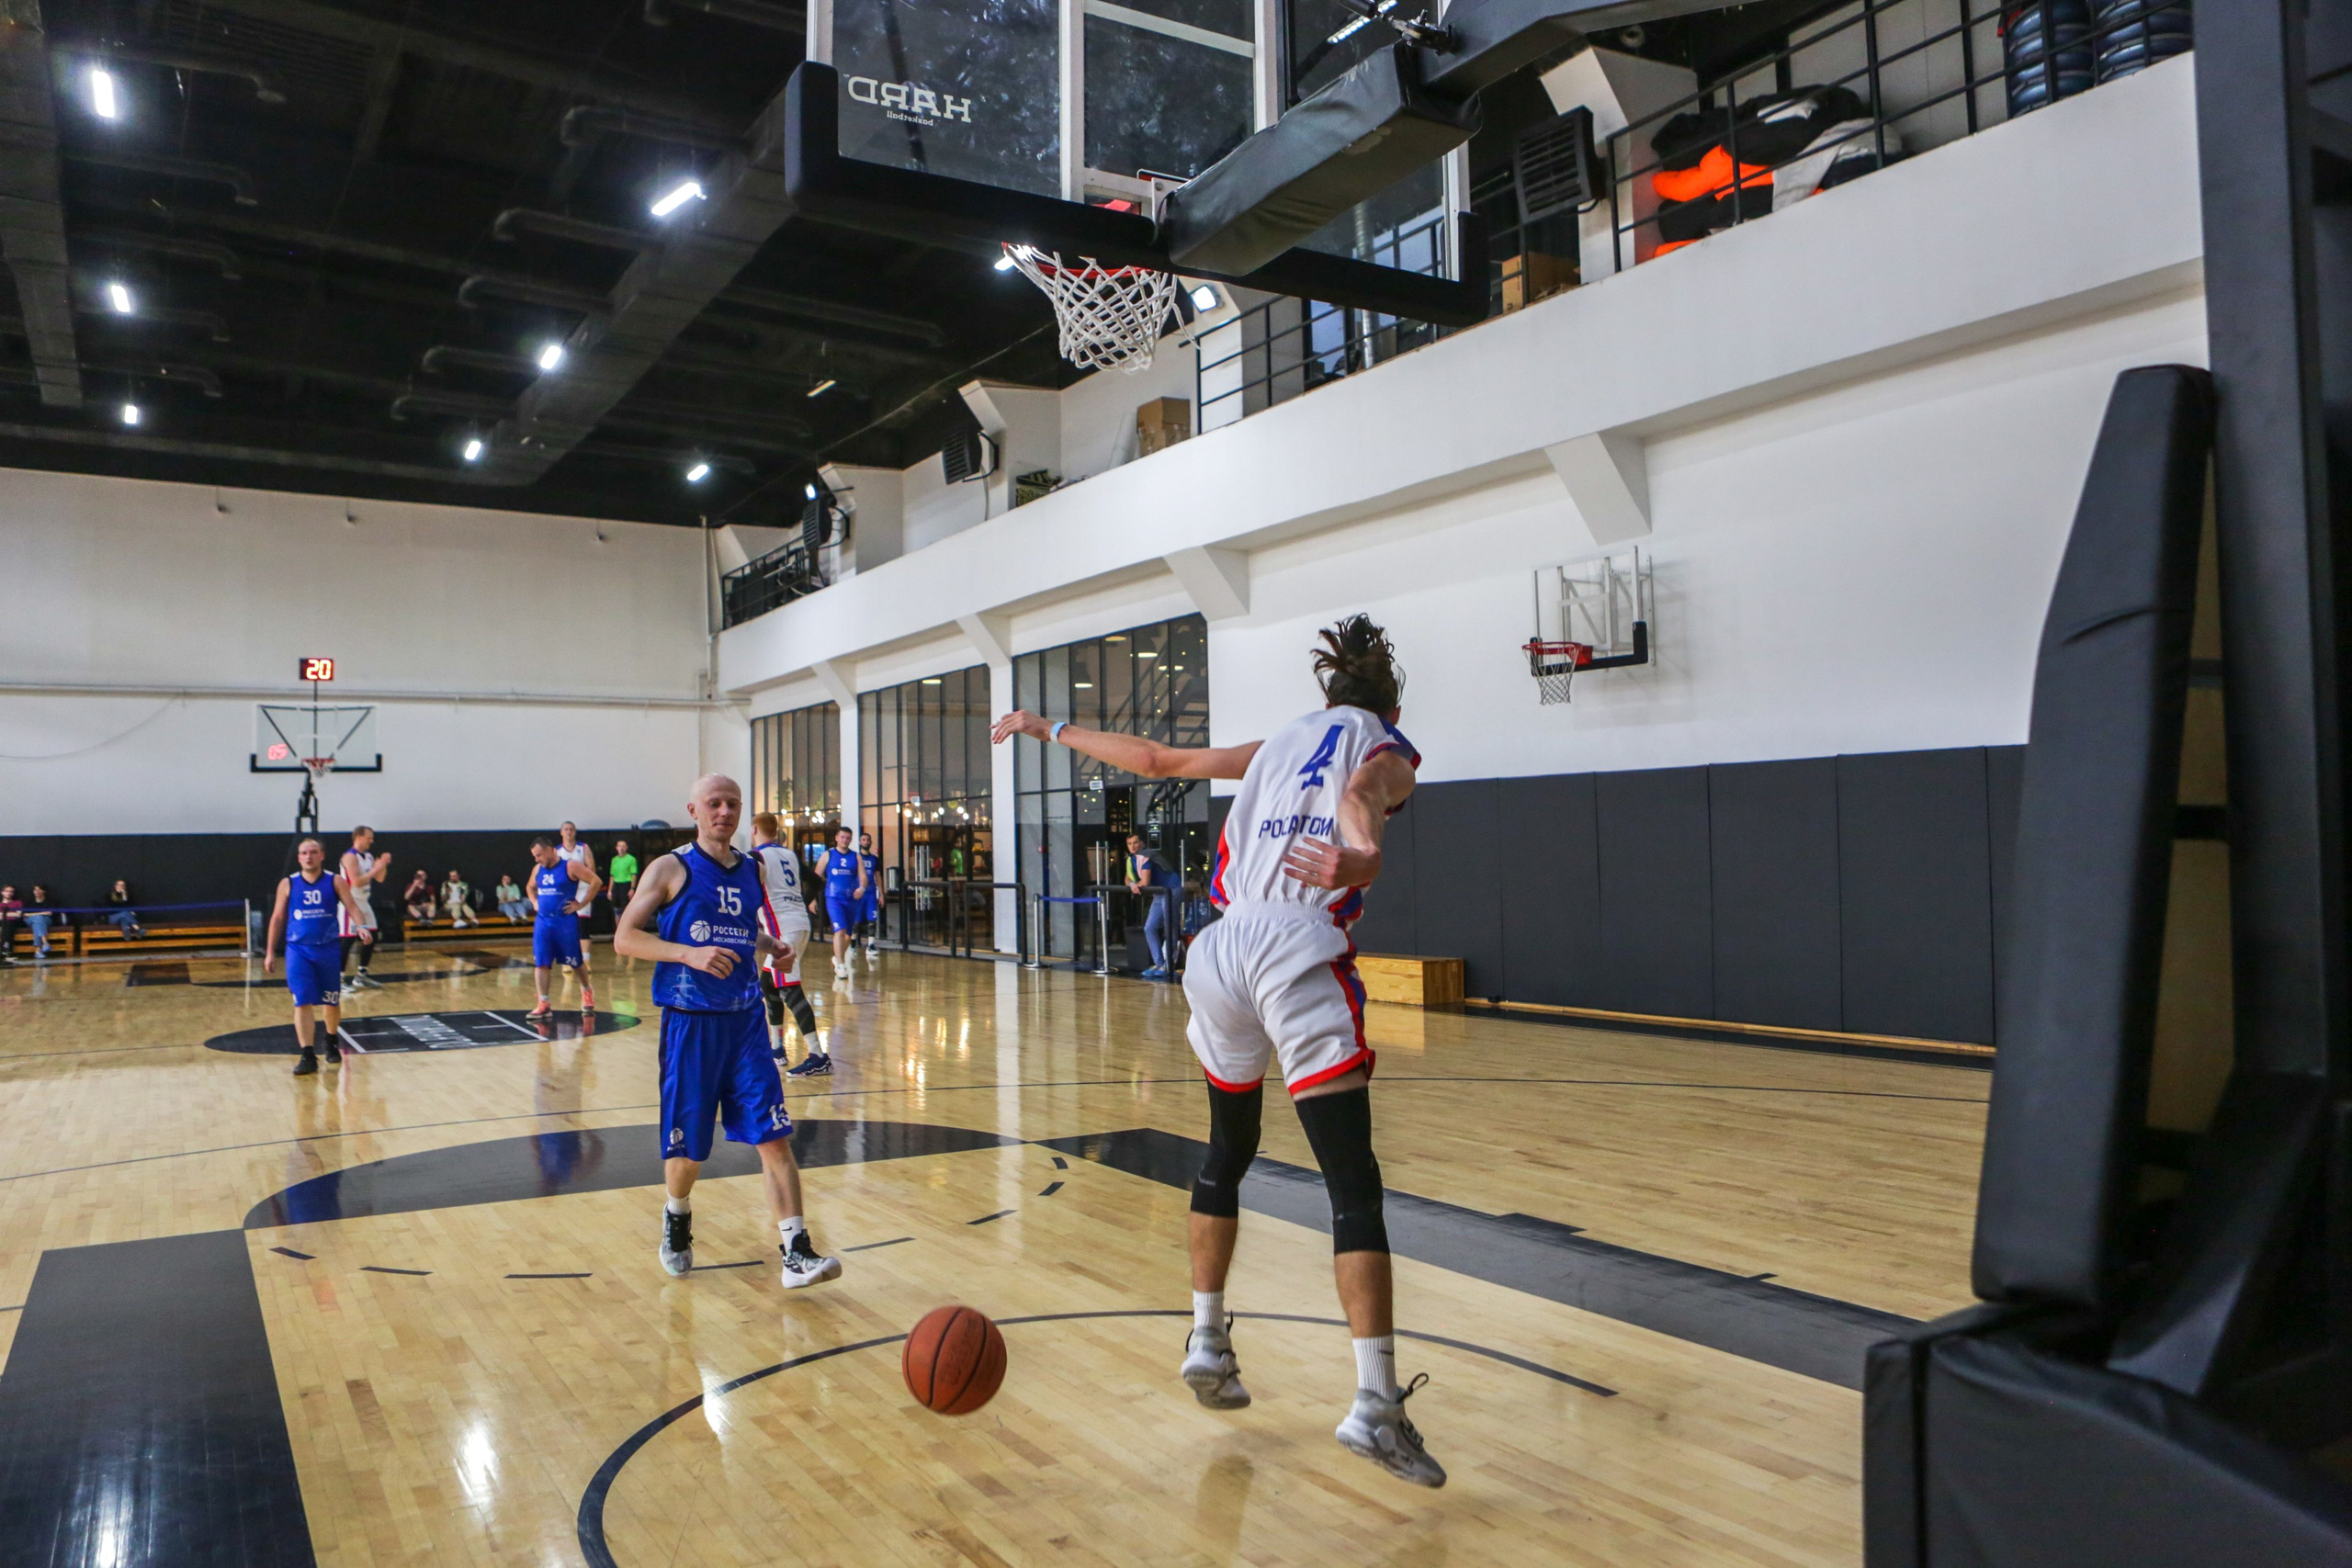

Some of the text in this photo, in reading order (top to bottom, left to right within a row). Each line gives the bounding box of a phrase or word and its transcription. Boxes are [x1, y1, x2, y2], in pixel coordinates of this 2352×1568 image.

[306, 659, 332, 680] 20
[1297, 724, 1346, 791] 4
[840, 857, 847, 867] 2
[542, 874, 555, 886] 24
[780, 860, 796, 886] 5
[303, 889, 322, 905] 30
[717, 885, 742, 917] 15
[713, 925, 749, 938] РОССЕТИ
[322, 990, 339, 1004] 30
